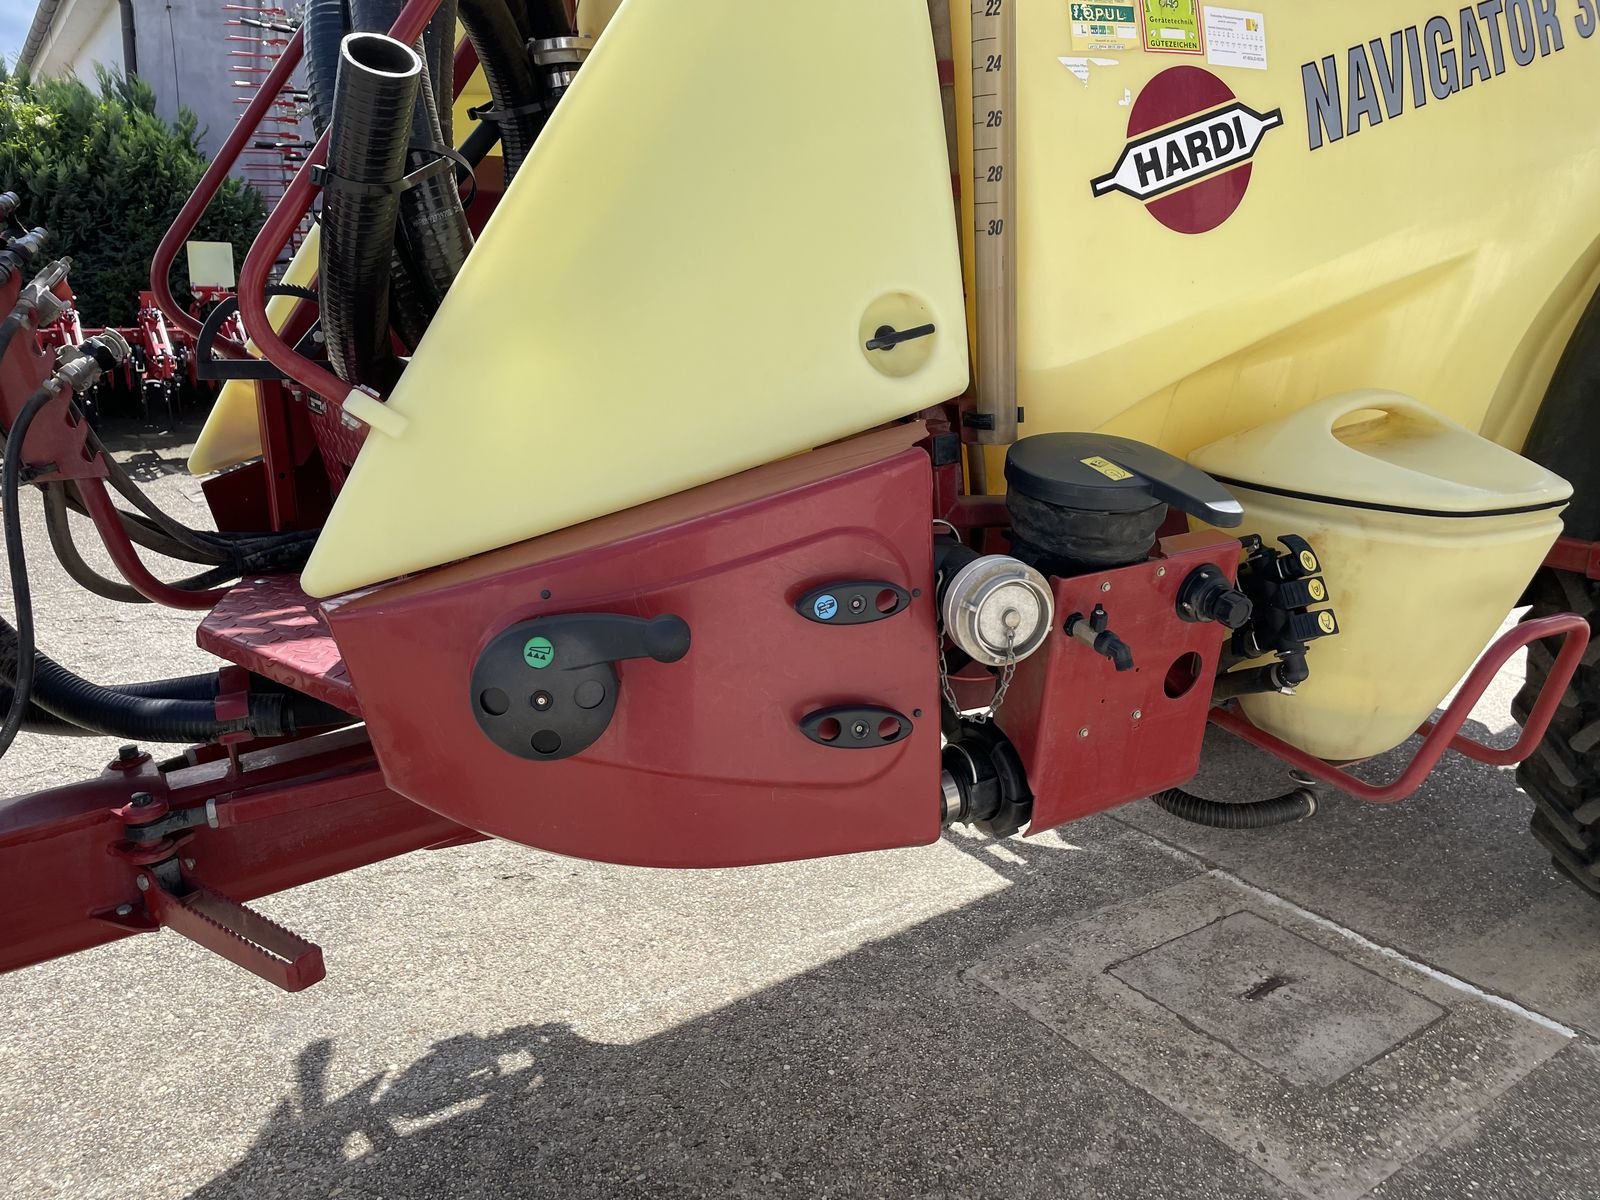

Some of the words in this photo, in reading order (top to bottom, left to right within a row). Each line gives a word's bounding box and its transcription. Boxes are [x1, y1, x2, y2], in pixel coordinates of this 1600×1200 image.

[985, 0, 1001, 16] 22
[985, 54, 1002, 72] 24
[1300, 0, 1565, 152] NAVIGATOR
[986, 110, 1003, 128] 26
[1133, 115, 1248, 189] HARDI
[987, 165, 1003, 183] 28
[987, 219, 1004, 236] 30
